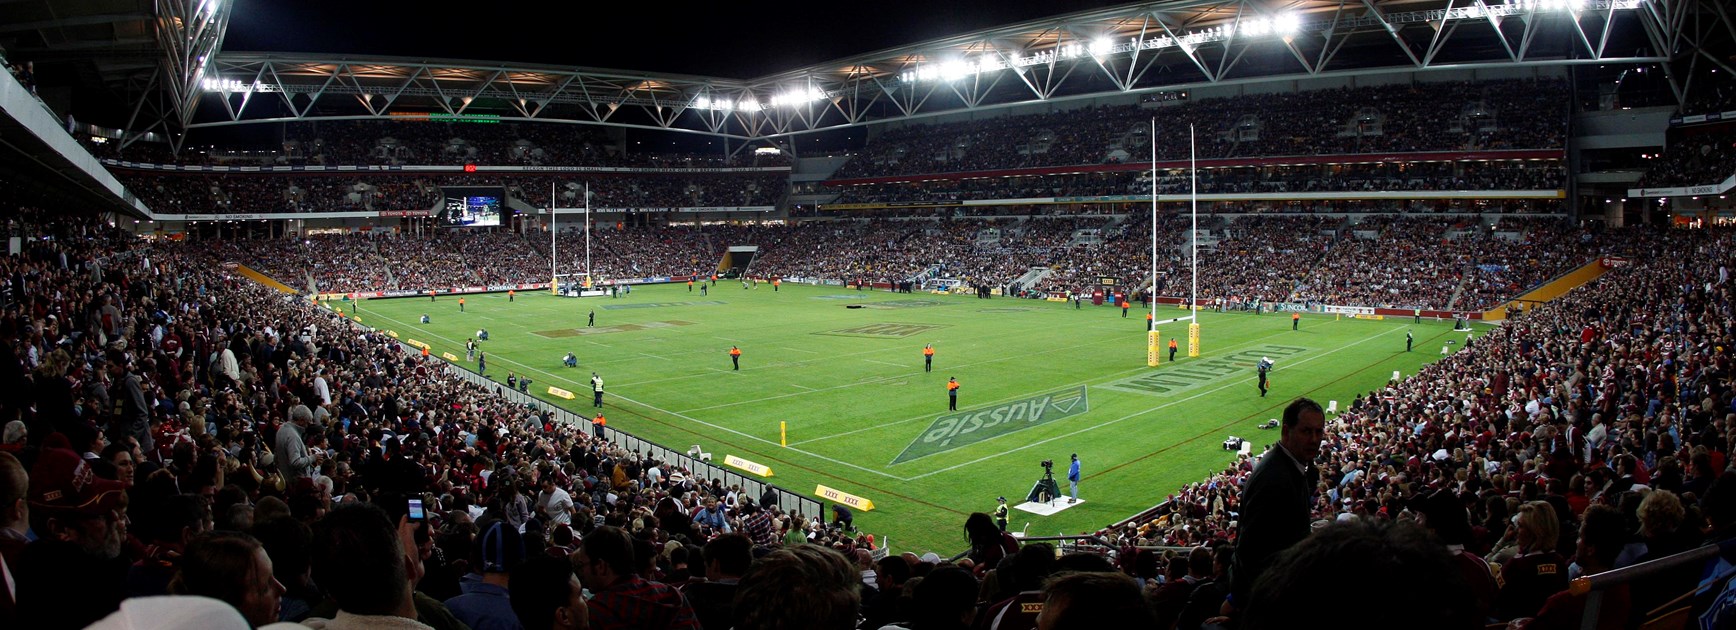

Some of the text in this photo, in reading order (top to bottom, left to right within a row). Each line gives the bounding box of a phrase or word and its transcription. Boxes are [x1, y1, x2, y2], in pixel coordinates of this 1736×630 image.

[1280, 303, 1308, 311] SUNCOR
[923, 396, 1050, 447] Aussie
[825, 490, 859, 506] XXXX XXXX
